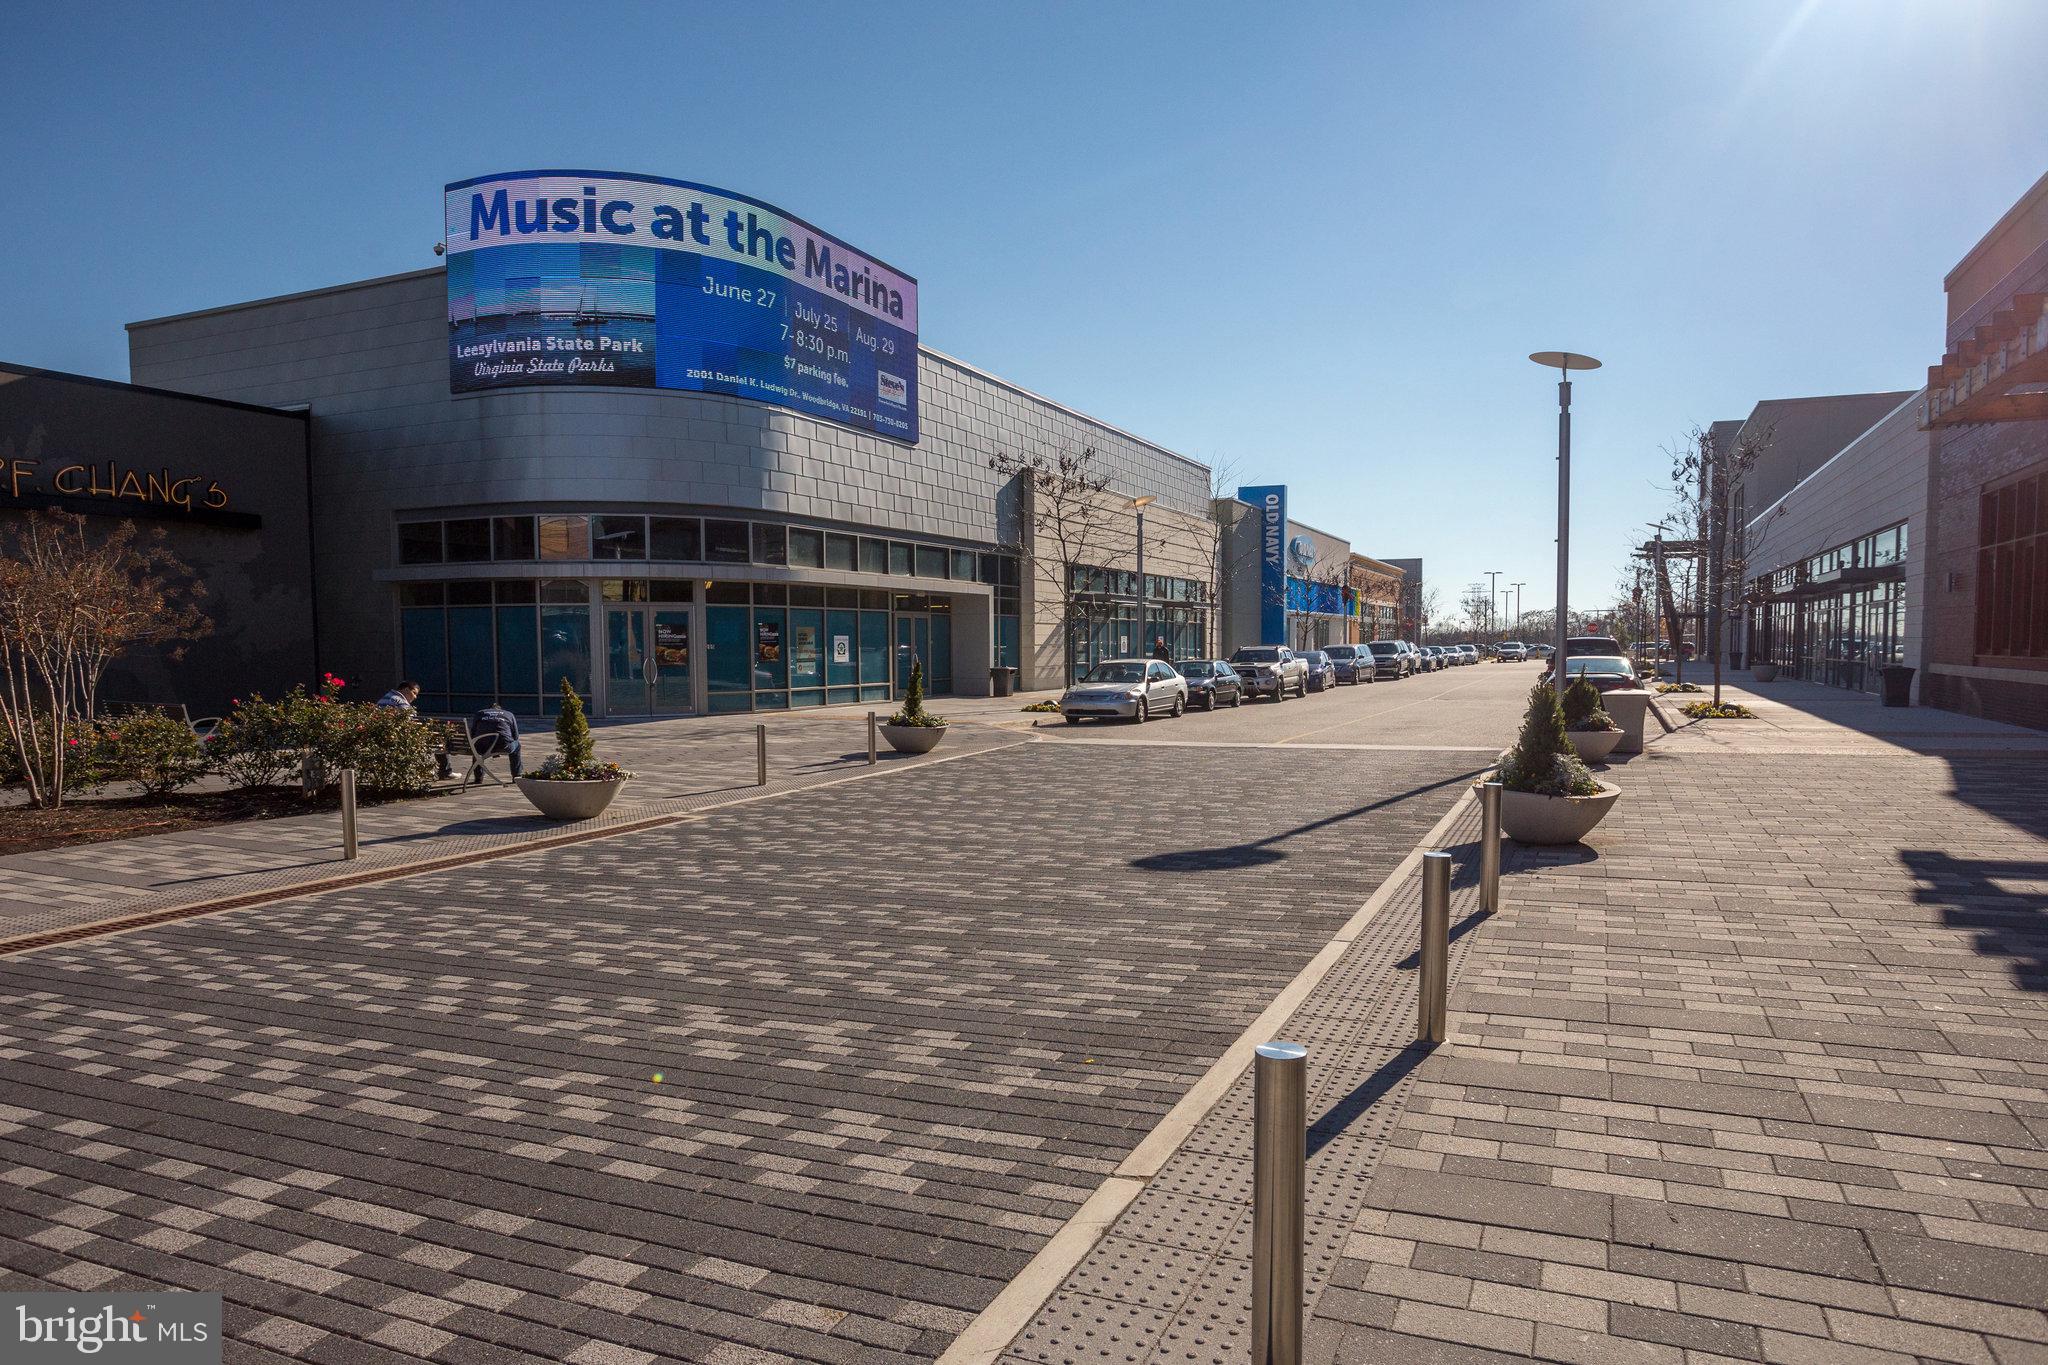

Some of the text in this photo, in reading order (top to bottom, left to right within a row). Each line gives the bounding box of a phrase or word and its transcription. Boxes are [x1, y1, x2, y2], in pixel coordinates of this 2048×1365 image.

[470, 186, 904, 320] Music at the Marina
[702, 276, 895, 355] June 27 July 25 Aug. 29
[457, 336, 643, 358] Leesylvania State Park
[827, 345, 852, 364] p.m.
[474, 357, 615, 378] Virginia State Parks
[784, 354, 849, 388] $7 parking fee.
[686, 369, 714, 380] 2001
[716, 372, 748, 385] Daniel
[749, 377, 759, 387] K.
[760, 380, 788, 396] Ludwig
[842, 403, 850, 412] VA
[1265, 495, 1280, 563] OLD NAVY
